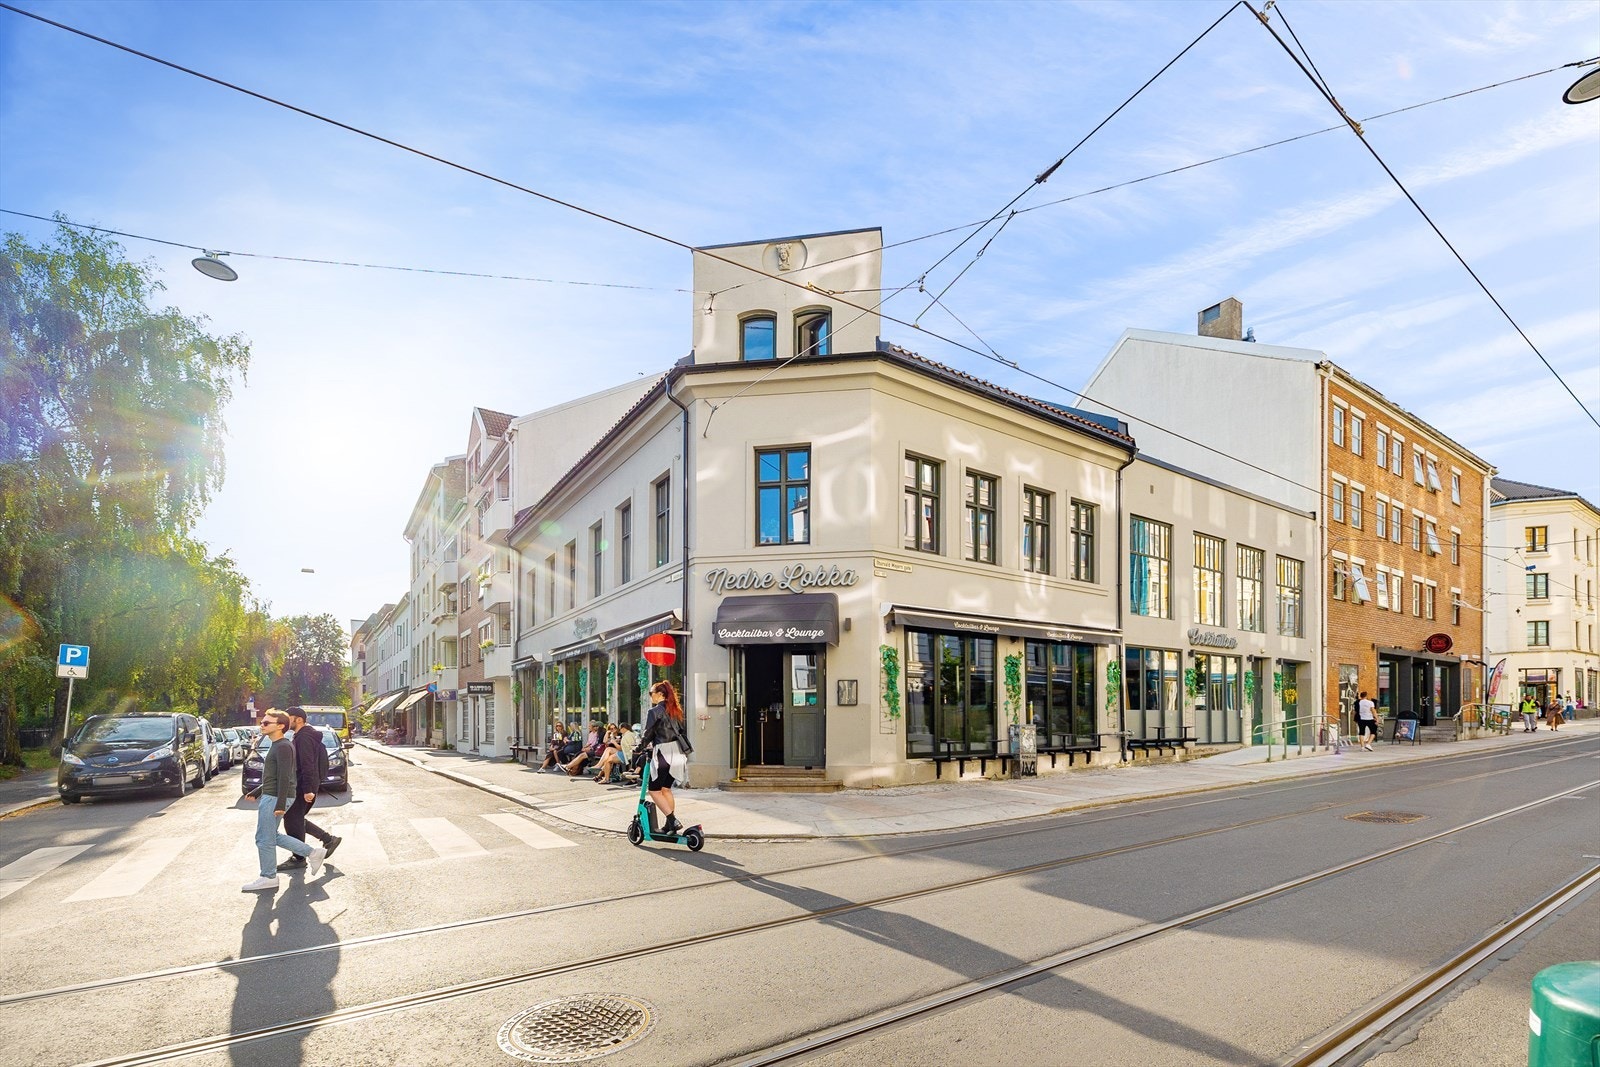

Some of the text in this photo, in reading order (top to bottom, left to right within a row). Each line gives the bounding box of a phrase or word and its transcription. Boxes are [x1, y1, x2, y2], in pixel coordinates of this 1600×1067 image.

[705, 562, 859, 595] Nedre Lokka
[718, 627, 825, 639] Cocktailbar & Lounge
[983, 624, 1000, 632] Lounge
[66, 647, 82, 663] P
